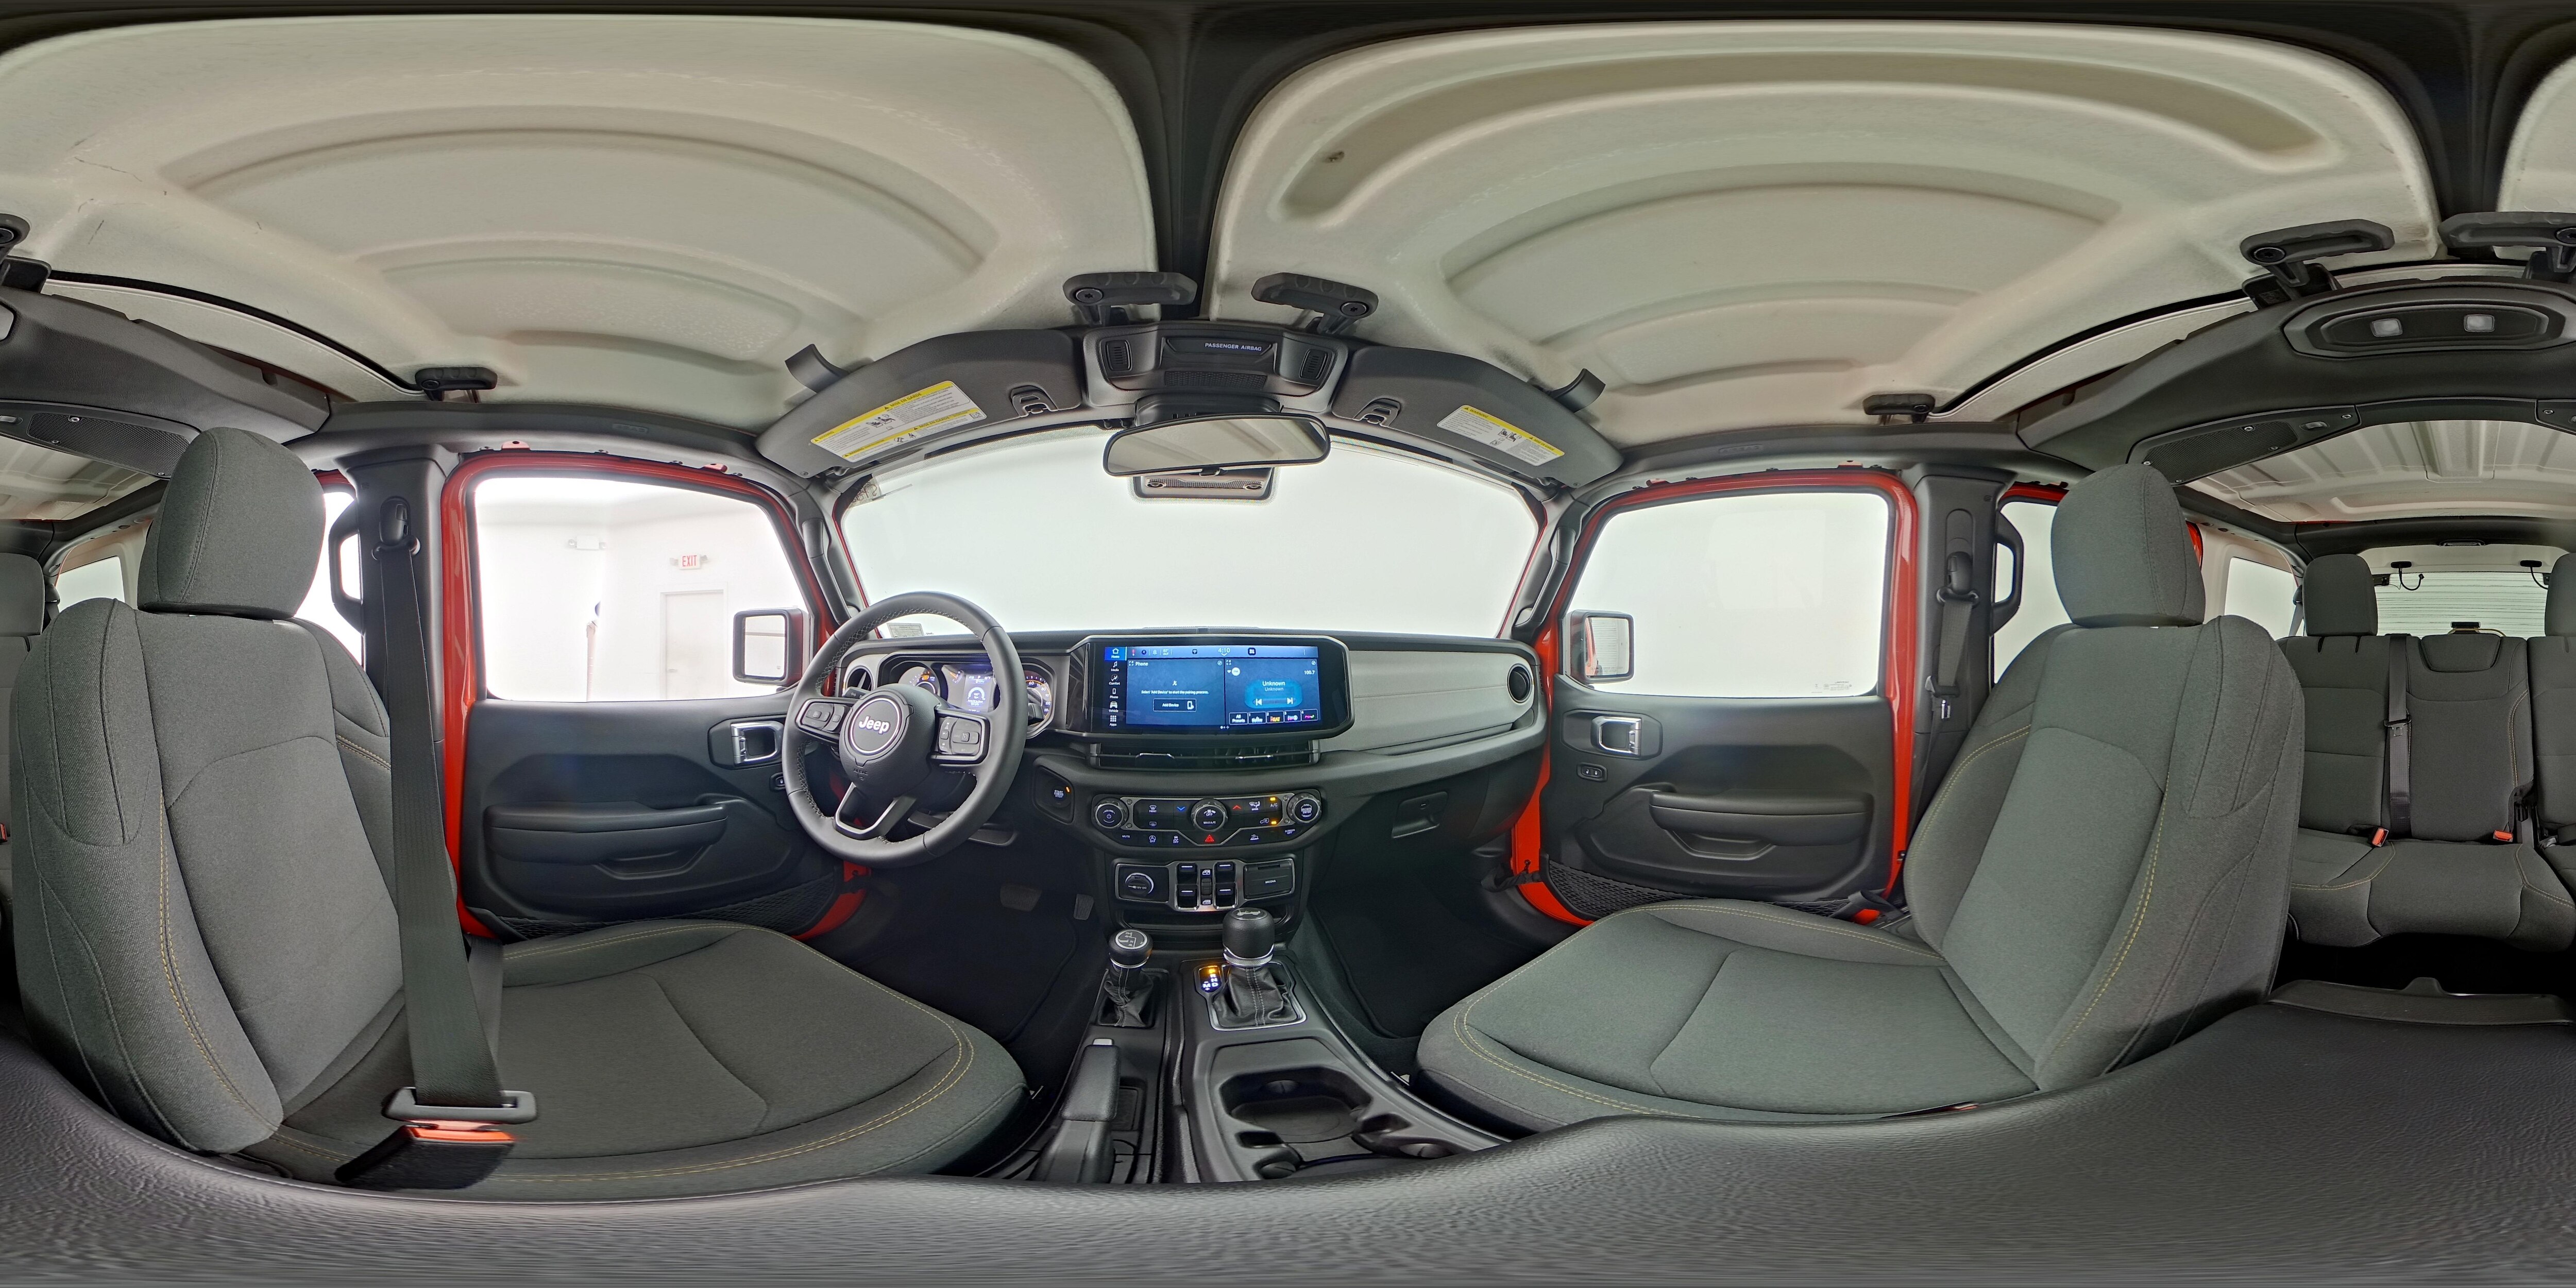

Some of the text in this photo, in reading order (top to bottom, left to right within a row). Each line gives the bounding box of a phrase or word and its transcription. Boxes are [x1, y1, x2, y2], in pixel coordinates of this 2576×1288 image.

[1469, 409, 1489, 418] WARNING
[682, 555, 697, 567] EXIT
[859, 716, 891, 734] Jeep
